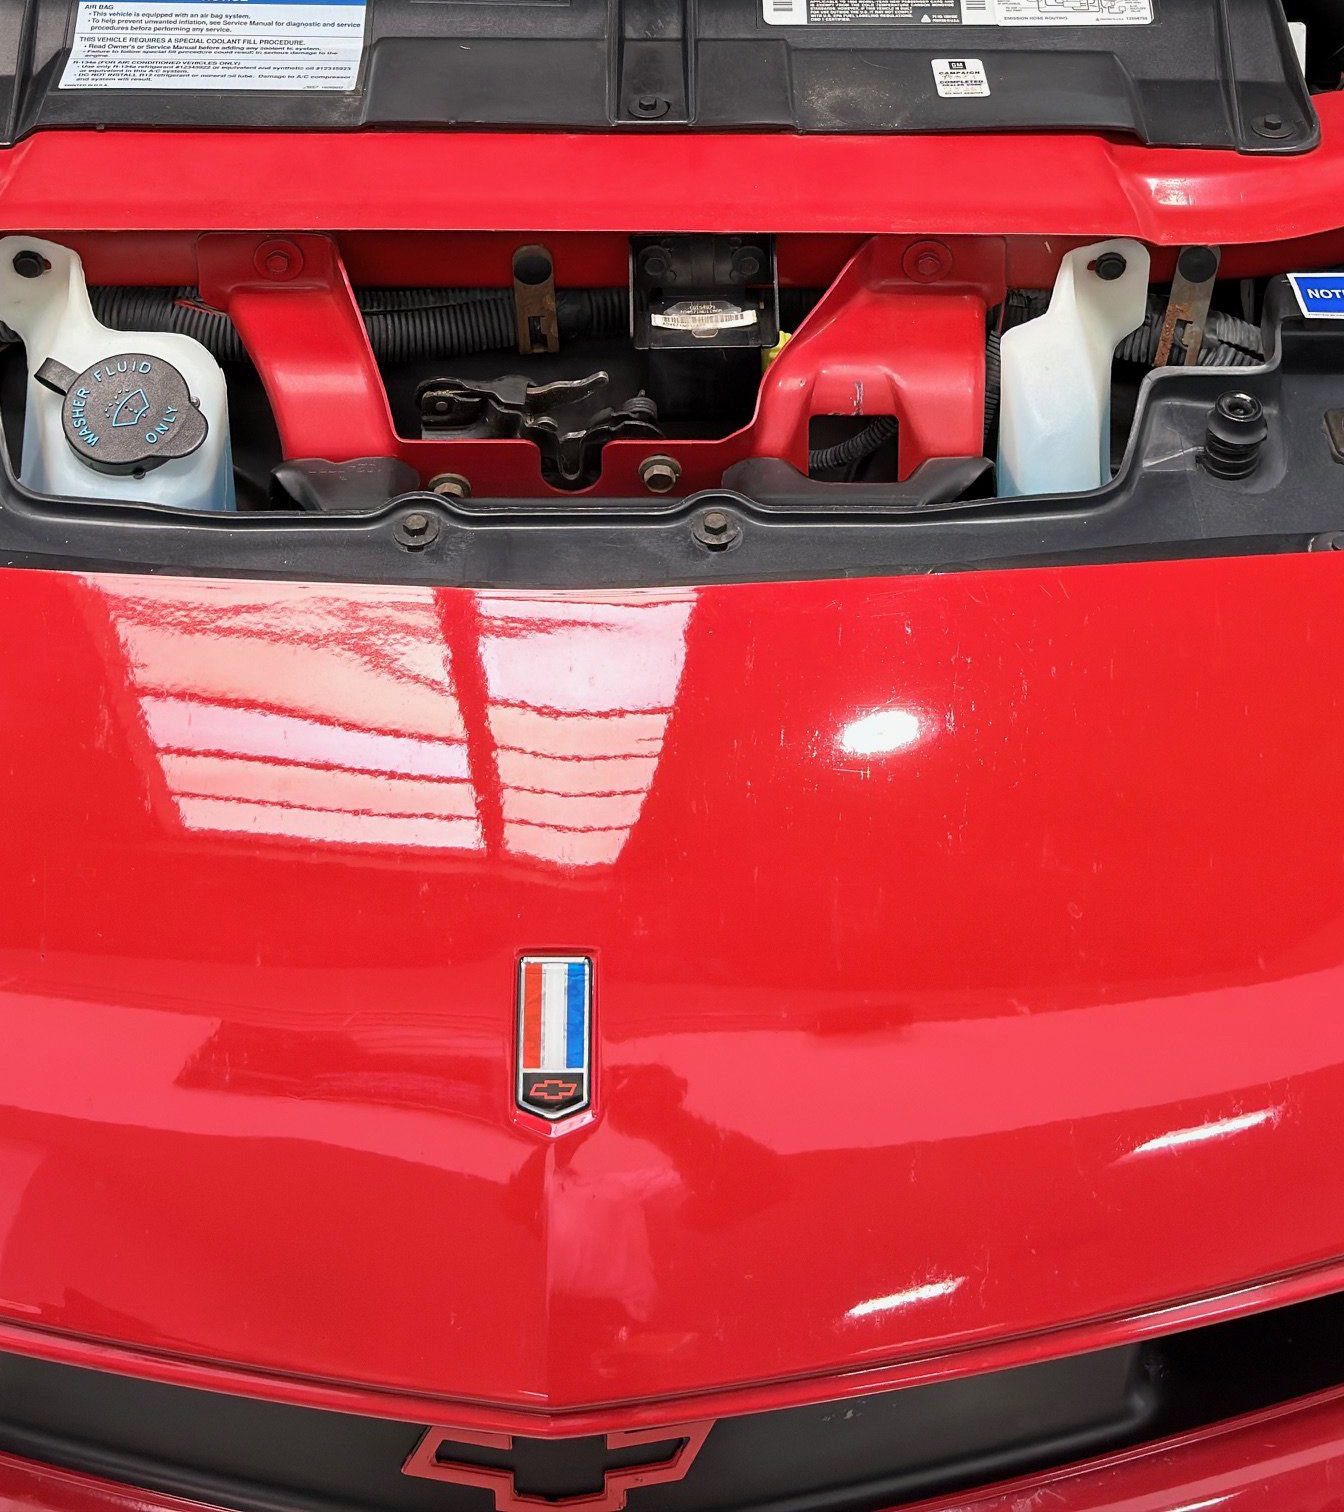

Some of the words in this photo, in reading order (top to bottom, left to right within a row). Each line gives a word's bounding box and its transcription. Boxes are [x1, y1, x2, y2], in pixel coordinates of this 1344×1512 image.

[71, 388, 100, 446] WASHER
[94, 361, 152, 382] FLUID
[145, 405, 178, 444] ONLY
